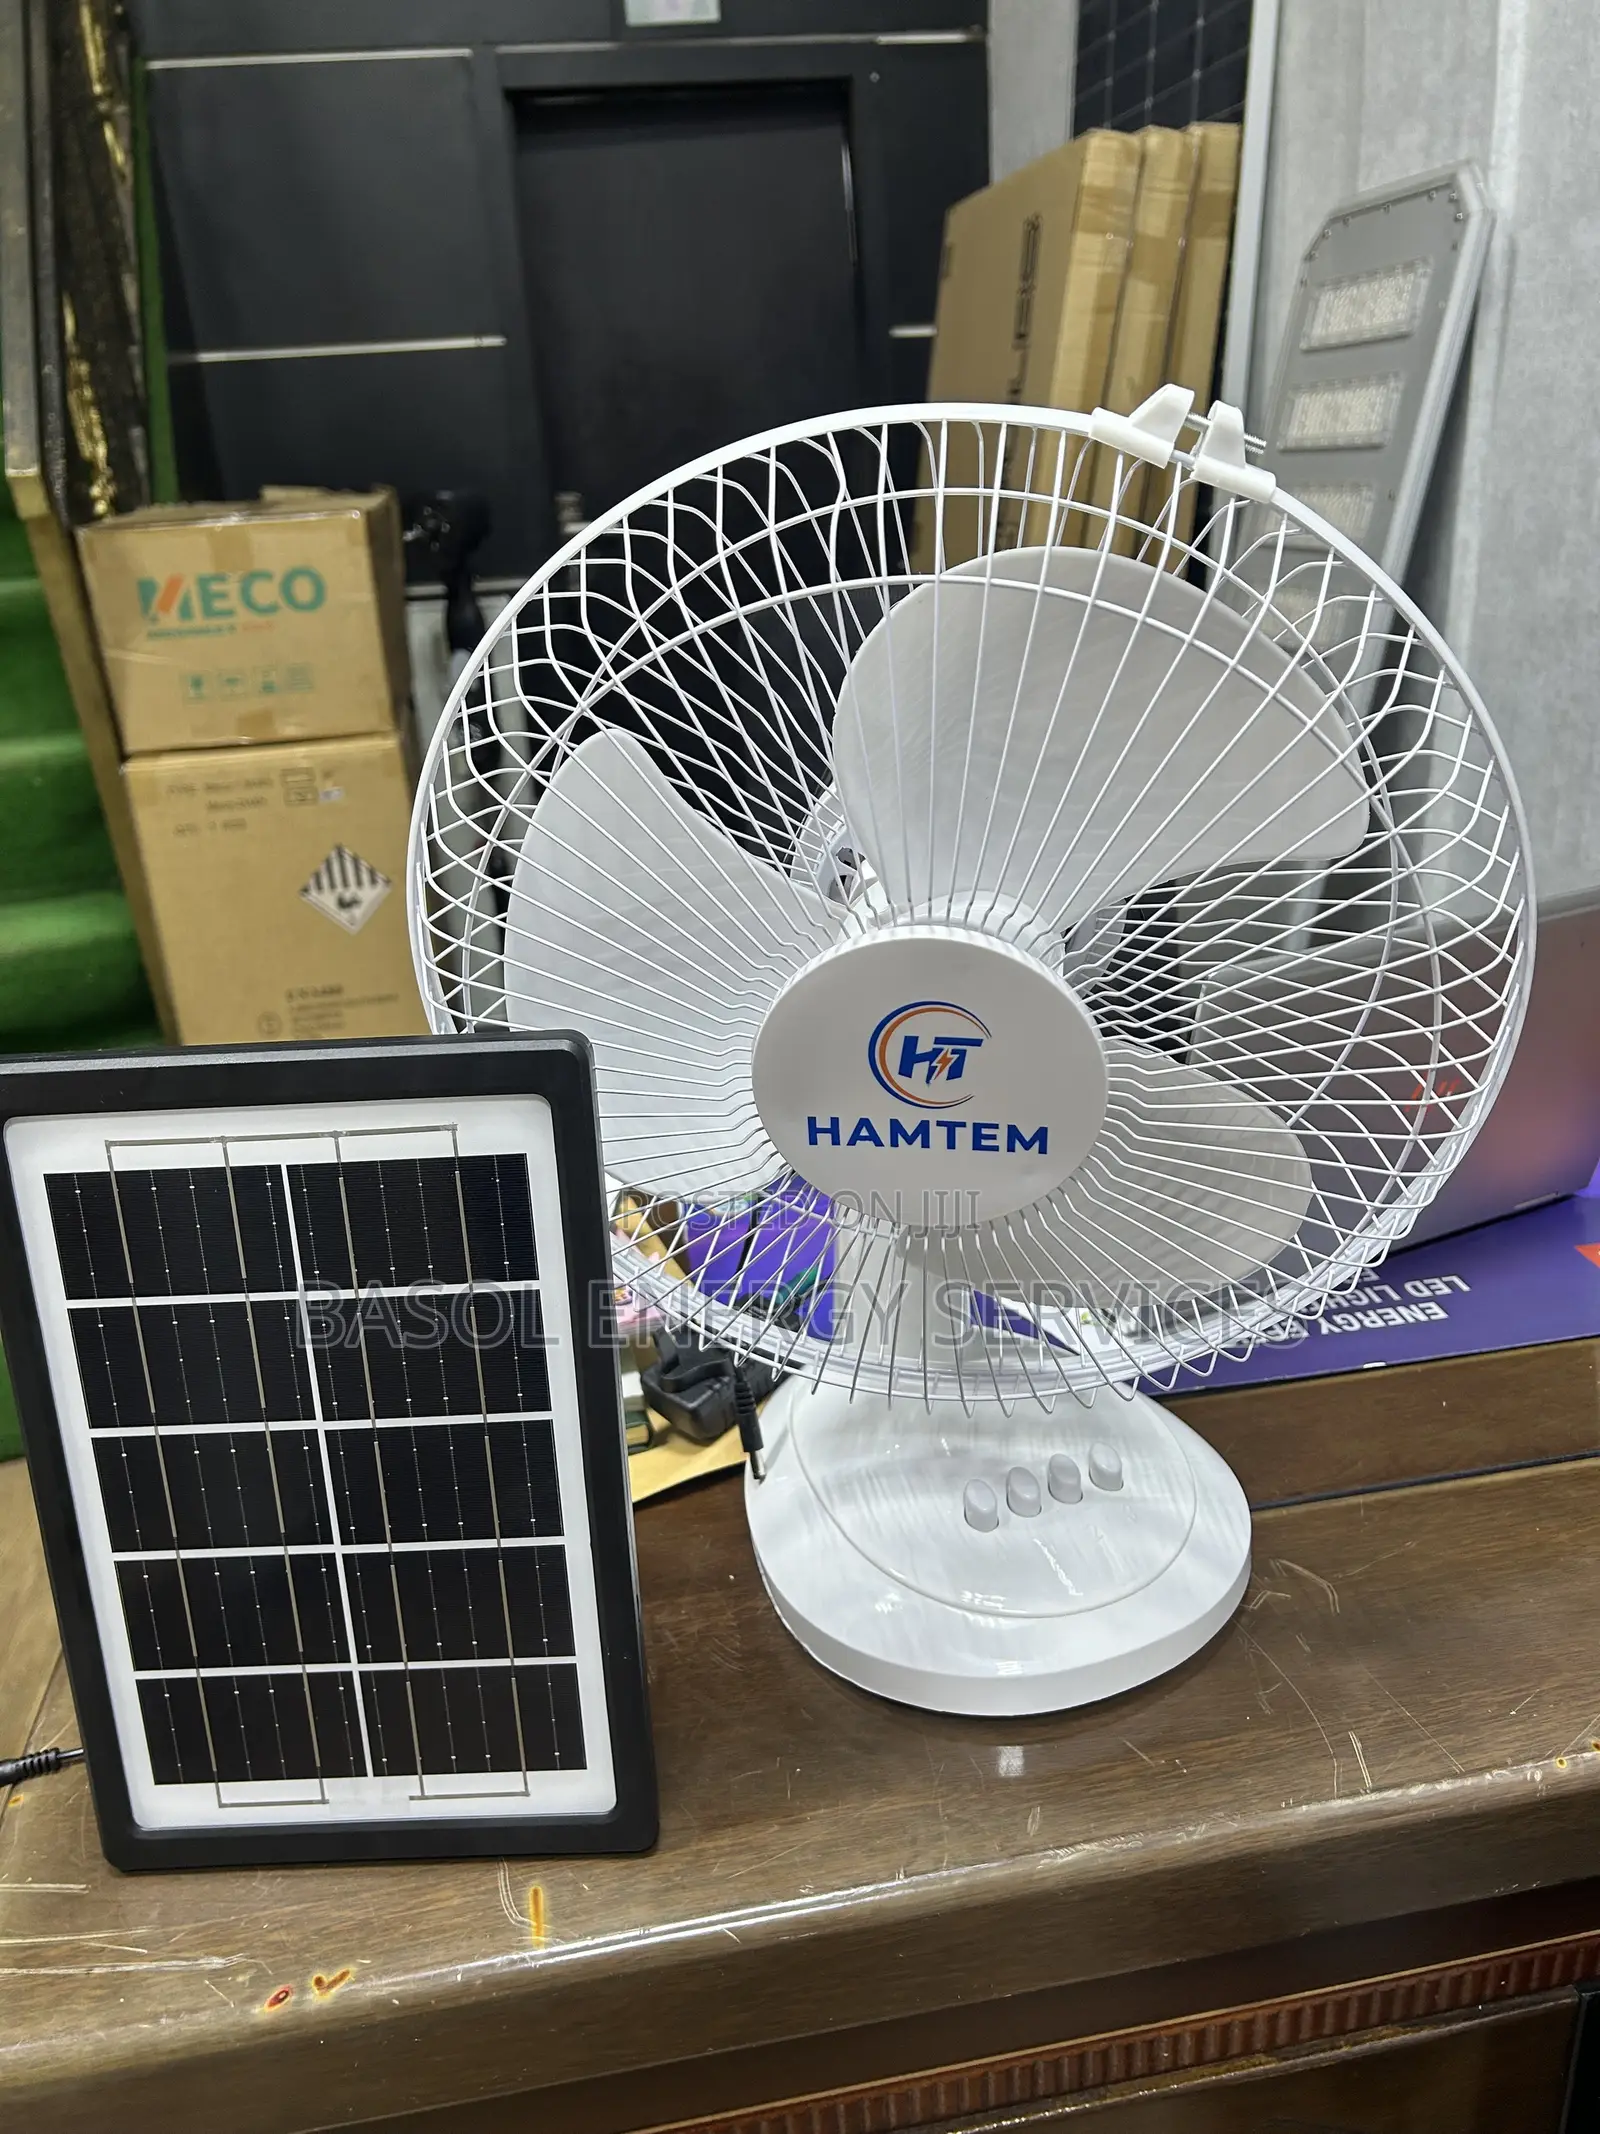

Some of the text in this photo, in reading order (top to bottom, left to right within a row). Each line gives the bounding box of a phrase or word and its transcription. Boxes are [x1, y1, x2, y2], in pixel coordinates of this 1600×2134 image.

[136, 565, 327, 623] MECO
[807, 1116, 1049, 1155] HAMTEM
[1404, 1275, 1471, 1299] LED
[1316, 1301, 1449, 1336] ENERGY
